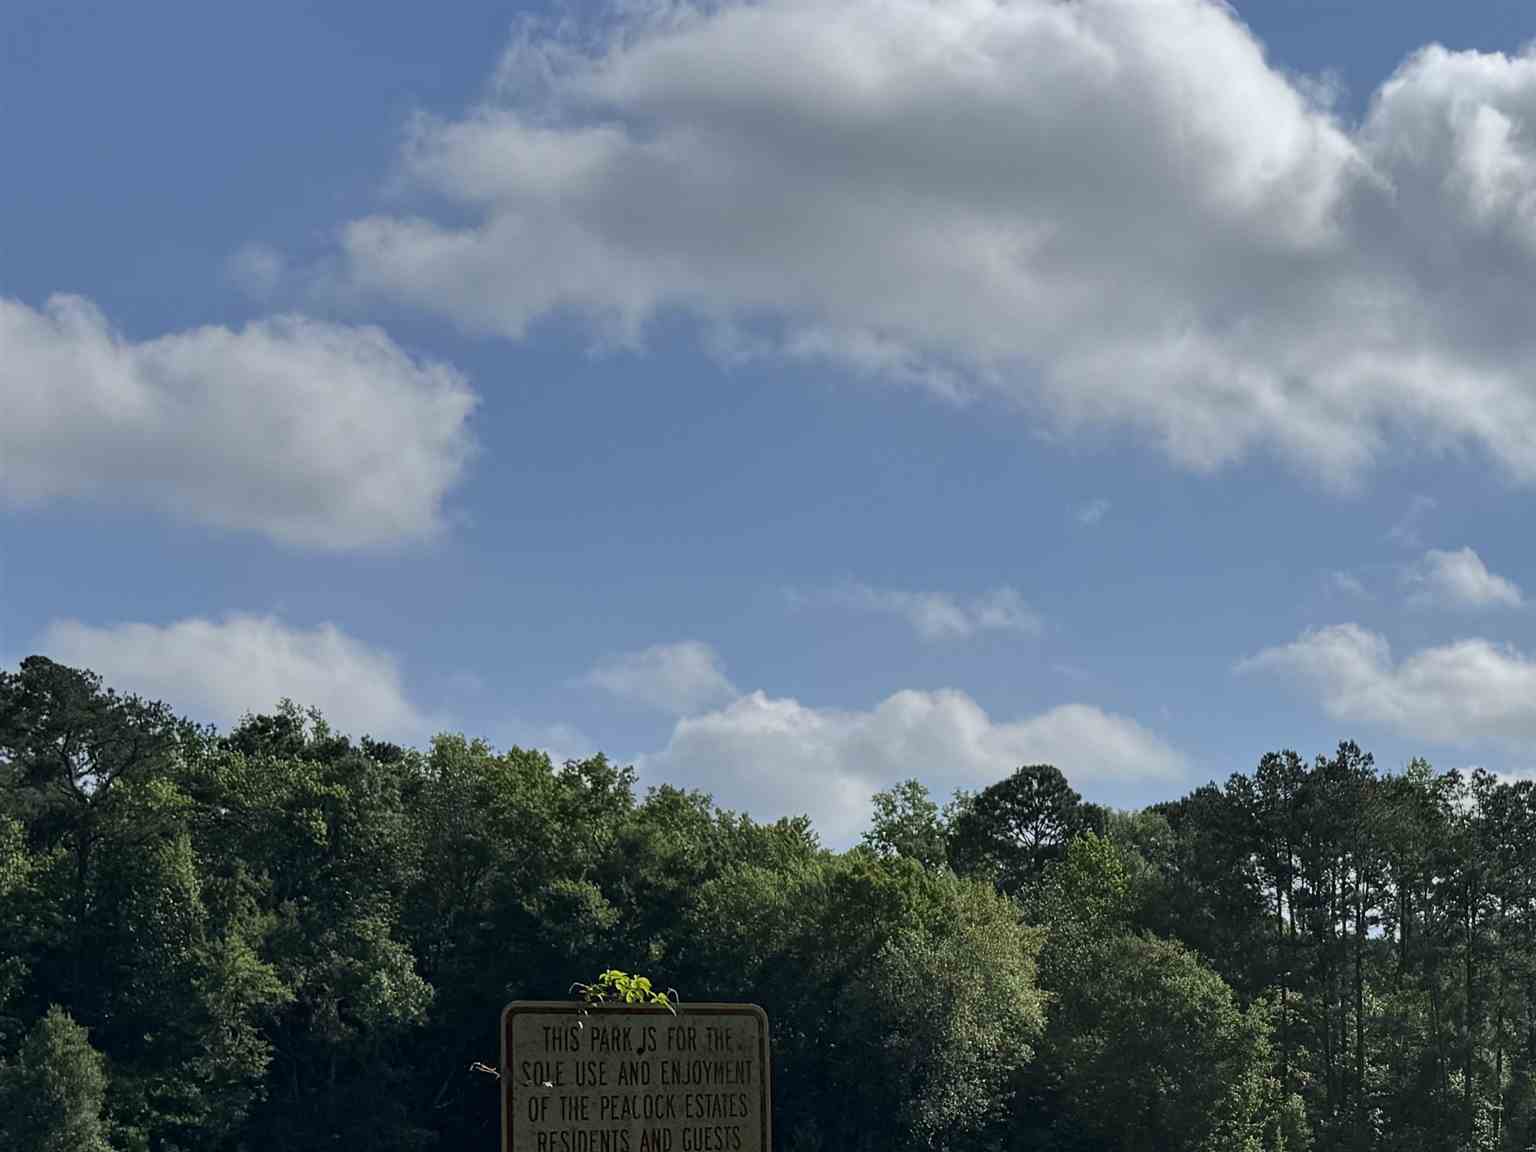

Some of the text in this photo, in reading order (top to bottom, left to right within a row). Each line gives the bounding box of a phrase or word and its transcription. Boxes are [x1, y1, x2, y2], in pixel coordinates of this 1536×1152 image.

[542, 1026, 734, 1053] THIS PARK IS FOR THE
[521, 1059, 753, 1087] SOLE USE AND ENJOYMENT
[528, 1092, 749, 1122] OF THE PEACOCK ESTATES
[682, 1125, 742, 1152] GUESTS
